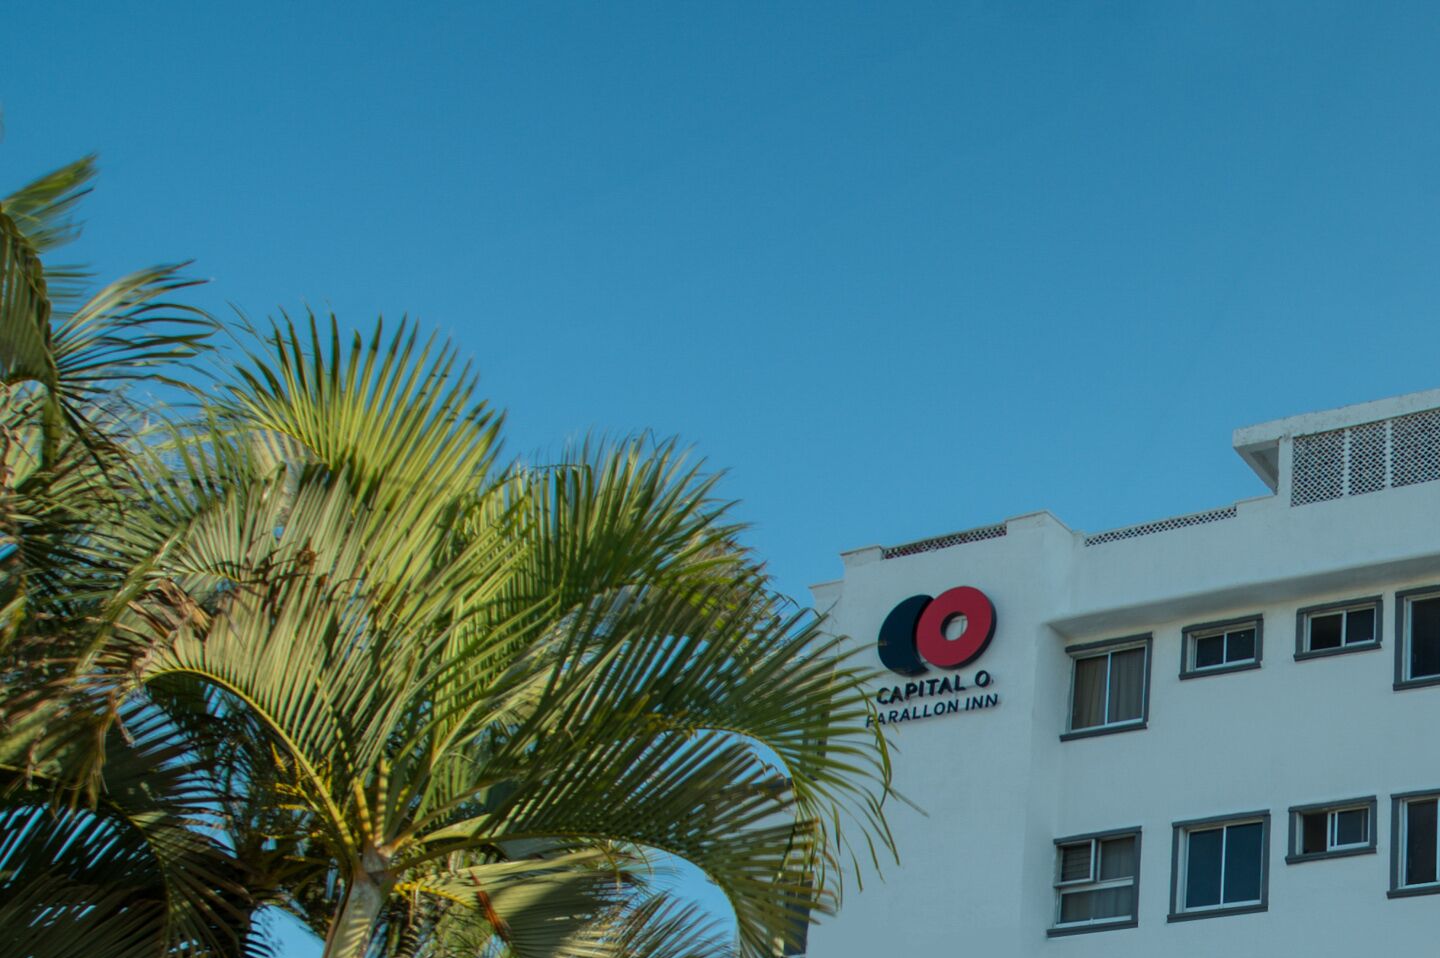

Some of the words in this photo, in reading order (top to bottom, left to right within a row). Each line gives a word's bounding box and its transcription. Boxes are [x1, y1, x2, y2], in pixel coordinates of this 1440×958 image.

[876, 674, 966, 705] CAPITAL
[975, 670, 991, 688] O
[965, 693, 998, 711] INN
